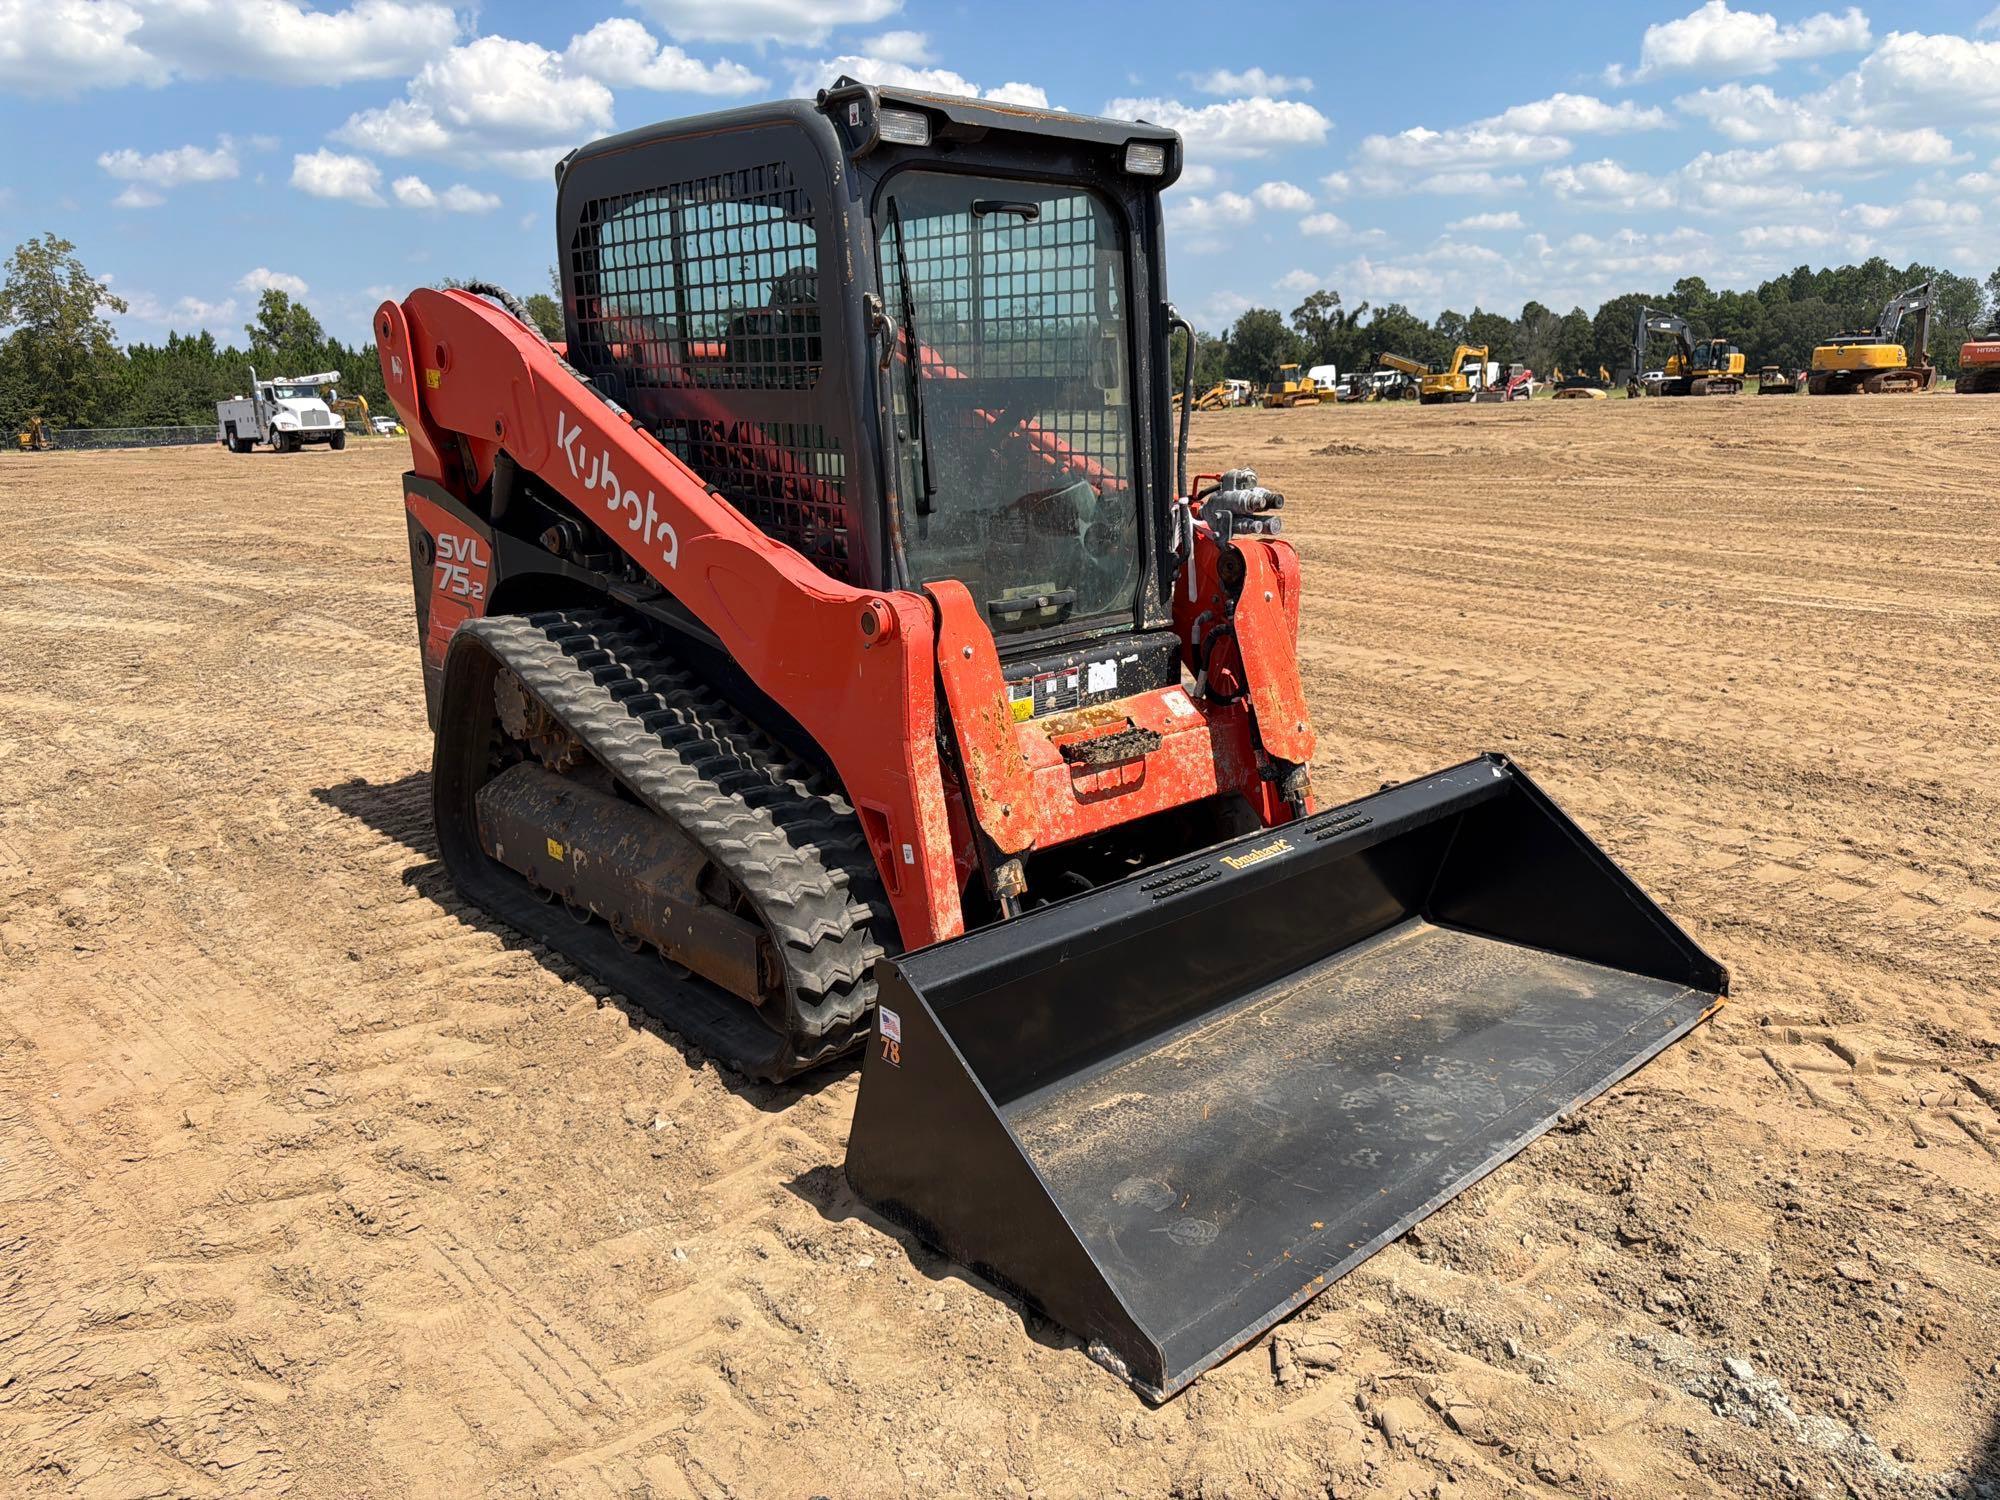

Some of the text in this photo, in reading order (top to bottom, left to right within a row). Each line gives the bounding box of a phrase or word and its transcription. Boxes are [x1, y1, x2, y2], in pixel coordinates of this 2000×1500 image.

[557, 410, 678, 570] Kubota
[436, 533, 487, 567] SVL
[1219, 839, 1293, 870] Tomahawk
[881, 1035, 900, 1064] 78
